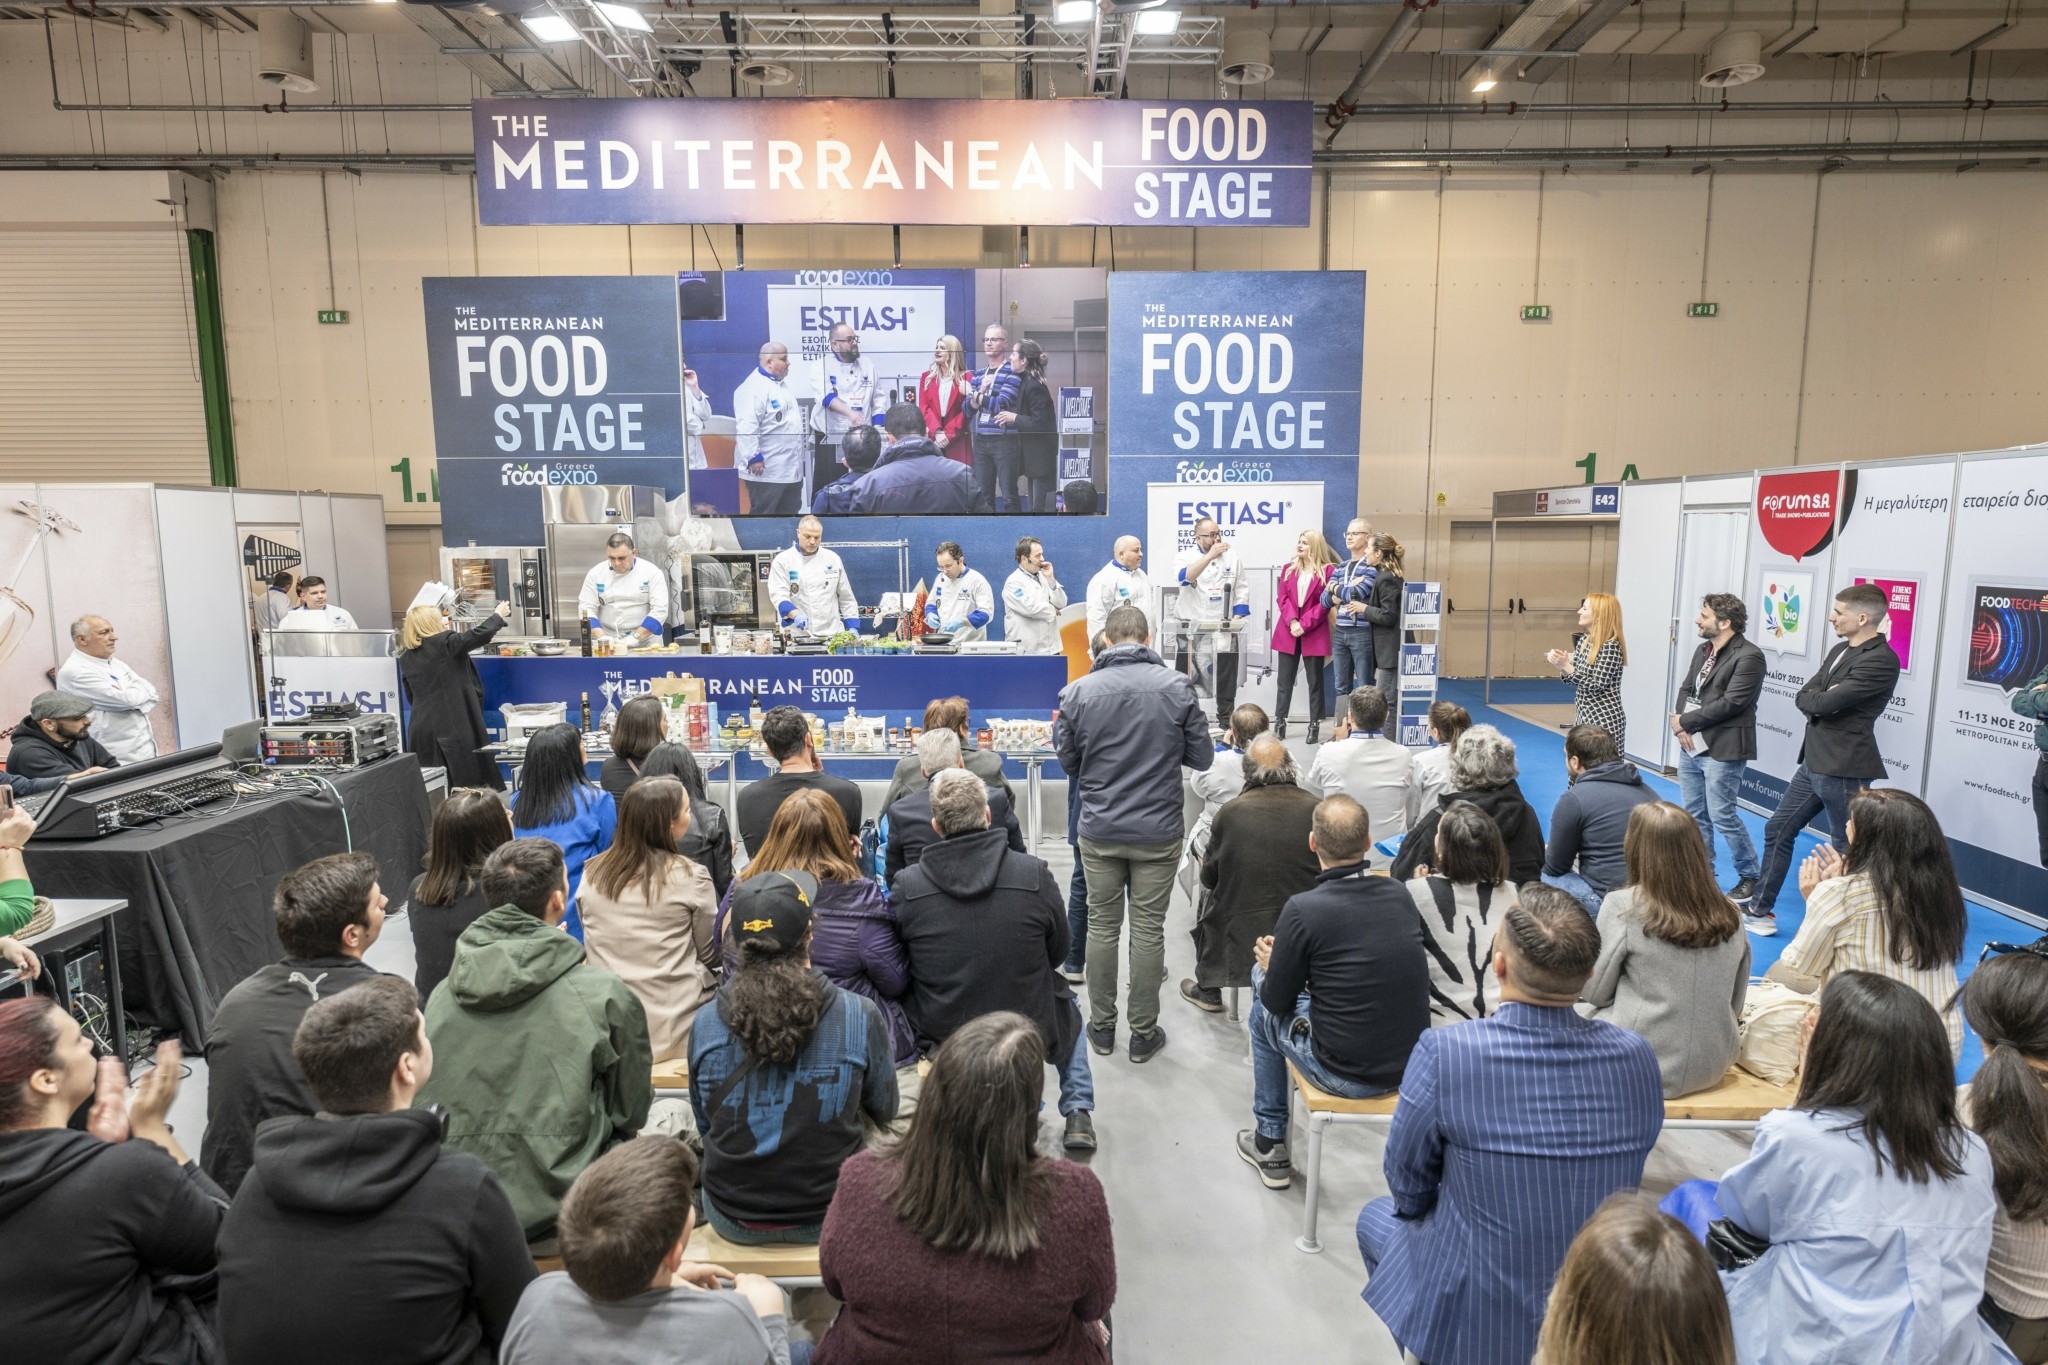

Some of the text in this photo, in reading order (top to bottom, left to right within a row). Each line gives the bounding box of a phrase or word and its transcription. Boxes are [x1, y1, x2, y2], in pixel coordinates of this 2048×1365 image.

[492, 115, 549, 137] THE
[1141, 107, 1266, 162] FOOD
[494, 140, 1104, 190] MEDITERRANEAN
[1134, 172, 1272, 219] STAGE
[455, 306, 476, 315] THE
[1145, 303, 1166, 312] THE
[454, 317, 603, 331] MEDITERRANEAN
[1142, 314, 1294, 328] MEDITERRANEAN
[456, 335, 608, 397] FOOD
[1142, 332, 1294, 395] FOOD
[1065, 397, 1091, 417] WELCOME
[494, 403, 645, 452] STAGE
[1172, 401, 1326, 449] STAGE
[1064, 458, 1090, 478] WELCOME
[1231, 460, 1272, 469] Greece
[1594, 494, 1616, 506] E42
[1864, 489, 2048, 514] Η μεγαλύτερη εταιρεία διο
[1891, 585, 1912, 595] ATHENS
[1891, 594, 1910, 602] COFFEE
[1408, 592, 1439, 613] WELCOME
[1889, 602, 1911, 611] FESTIVAL
[1784, 608, 1798, 620] bio
[1405, 655, 1435, 674] WELCOME
[603, 671, 623, 679] THE
[812, 668, 854, 686] FOOD
[1788, 675, 1805, 685] 2023
[605, 679, 803, 695] MEDRANEAN
[811, 687, 857, 703] STAGE
[1888, 695, 1906, 707] 023
[1958, 709, 1988, 724] 11-13
[1757, 722, 1793, 738] ww.biofestival.gr
[1956, 728, 2039, 751] METROPOLITAN EXP
[1963, 779, 2032, 804] www.foodtech.gr
